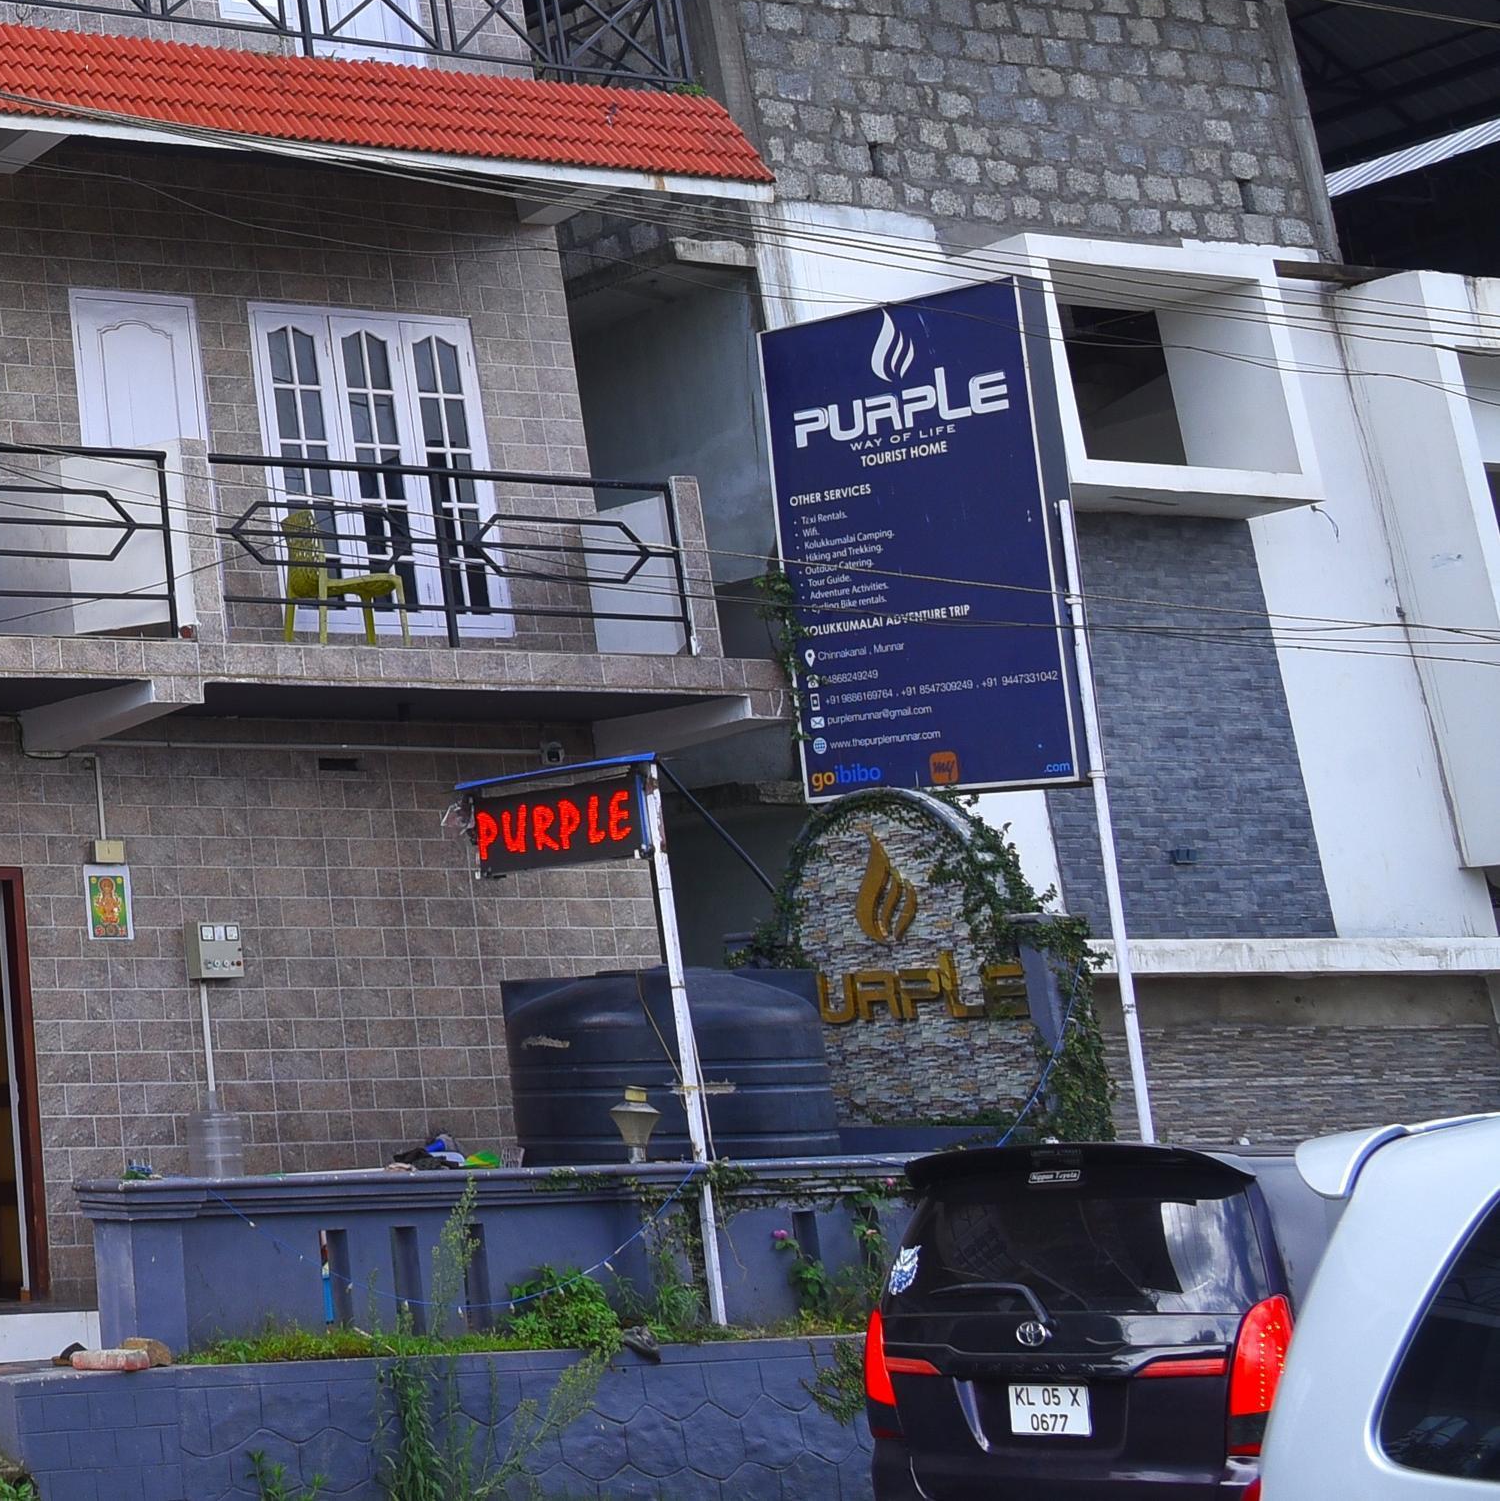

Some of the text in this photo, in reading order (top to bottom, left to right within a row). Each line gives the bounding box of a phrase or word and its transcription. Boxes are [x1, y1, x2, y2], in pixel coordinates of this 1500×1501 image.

[794, 367, 1009, 448] PURPLE
[850, 424, 956, 451] WAY OF LIFE
[861, 441, 948, 467] TOURIST HOME
[789, 484, 871, 507] OTHER SERVICES
[804, 534, 856, 549] Kolukkumalai
[806, 551, 831, 563] Hiking
[832, 548, 847, 558] and
[808, 578, 825, 587] Tour
[810, 587, 850, 600] Adventure
[841, 598, 857, 609] Bike
[887, 609, 947, 625] ADVENTURE
[948, 604, 971, 618] TRIP
[873, 642, 904, 654] Munnar
[982, 677, 997, 688] +91
[827, 705, 932, 726] purplemunnar@gmail.com
[830, 730, 941, 750] www.thepurplemunnar.com
[812, 763, 881, 792] goibibo
[476, 790, 632, 861] PURPLE
[816, 949, 1031, 1025] URPLE
[1014, 1387, 1081, 1407] KL 05 X
[1030, 1413, 1068, 1432] 0677
